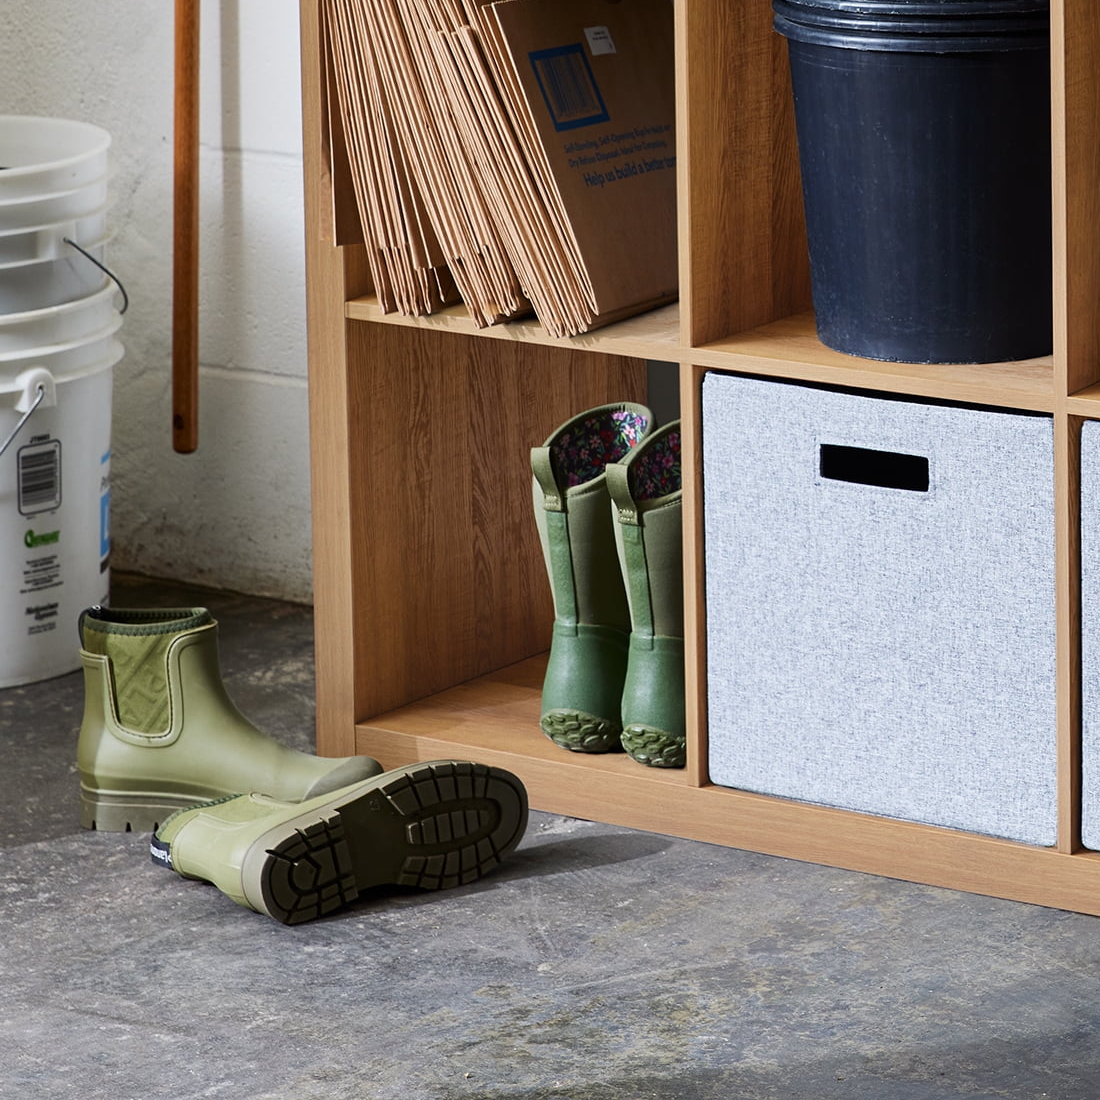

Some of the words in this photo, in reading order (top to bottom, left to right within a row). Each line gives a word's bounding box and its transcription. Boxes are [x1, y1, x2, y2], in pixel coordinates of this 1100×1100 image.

[583, 172, 605, 188] Help
[605, 172, 617, 182] us
[614, 162, 638, 180] build
[638, 164, 644, 174] a
